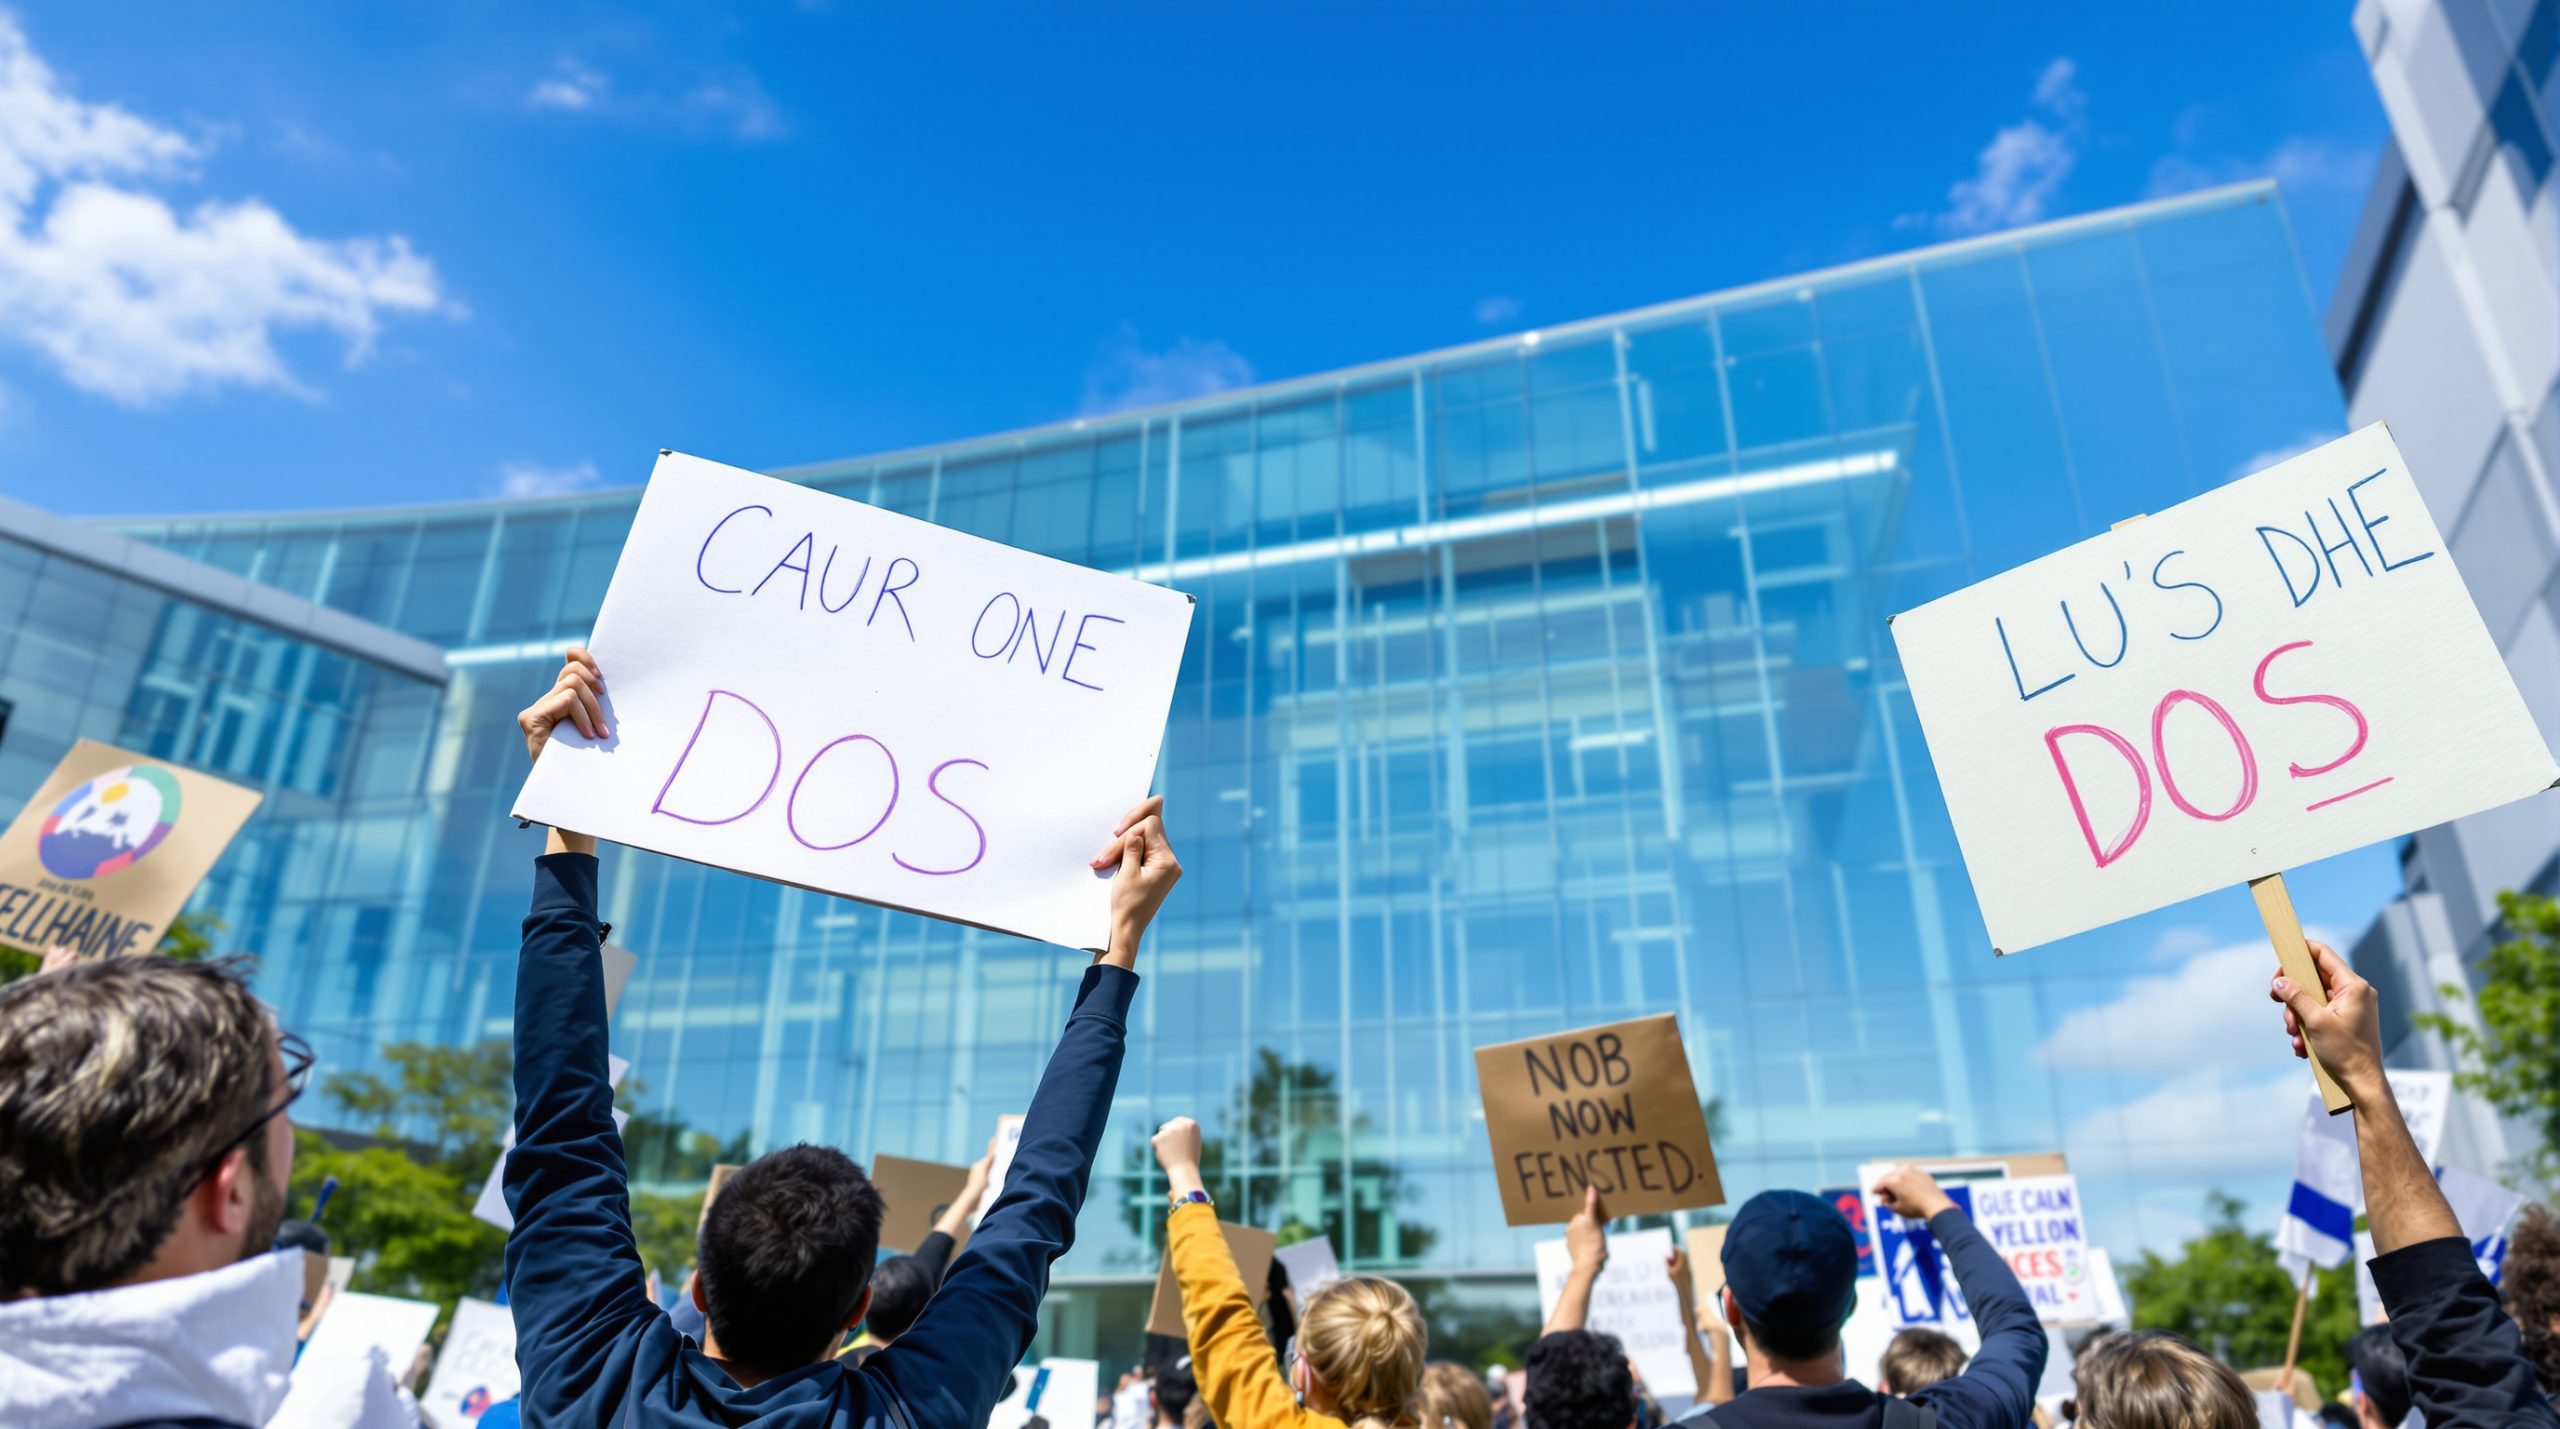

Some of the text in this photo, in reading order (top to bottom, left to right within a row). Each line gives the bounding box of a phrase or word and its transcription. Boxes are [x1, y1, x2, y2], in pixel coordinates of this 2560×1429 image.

[697, 505, 1126, 691] CAUR ONE
[1995, 468, 2435, 701] LU'S DHE
[651, 688, 989, 875] DOS
[2044, 641, 2368, 868] DOS
[1524, 1033, 1631, 1096] NOB
[1548, 1092, 1636, 1141] NOW
[1513, 1141, 1704, 1202] FENSTED.
[2003, 1249, 2063, 1279] CES
